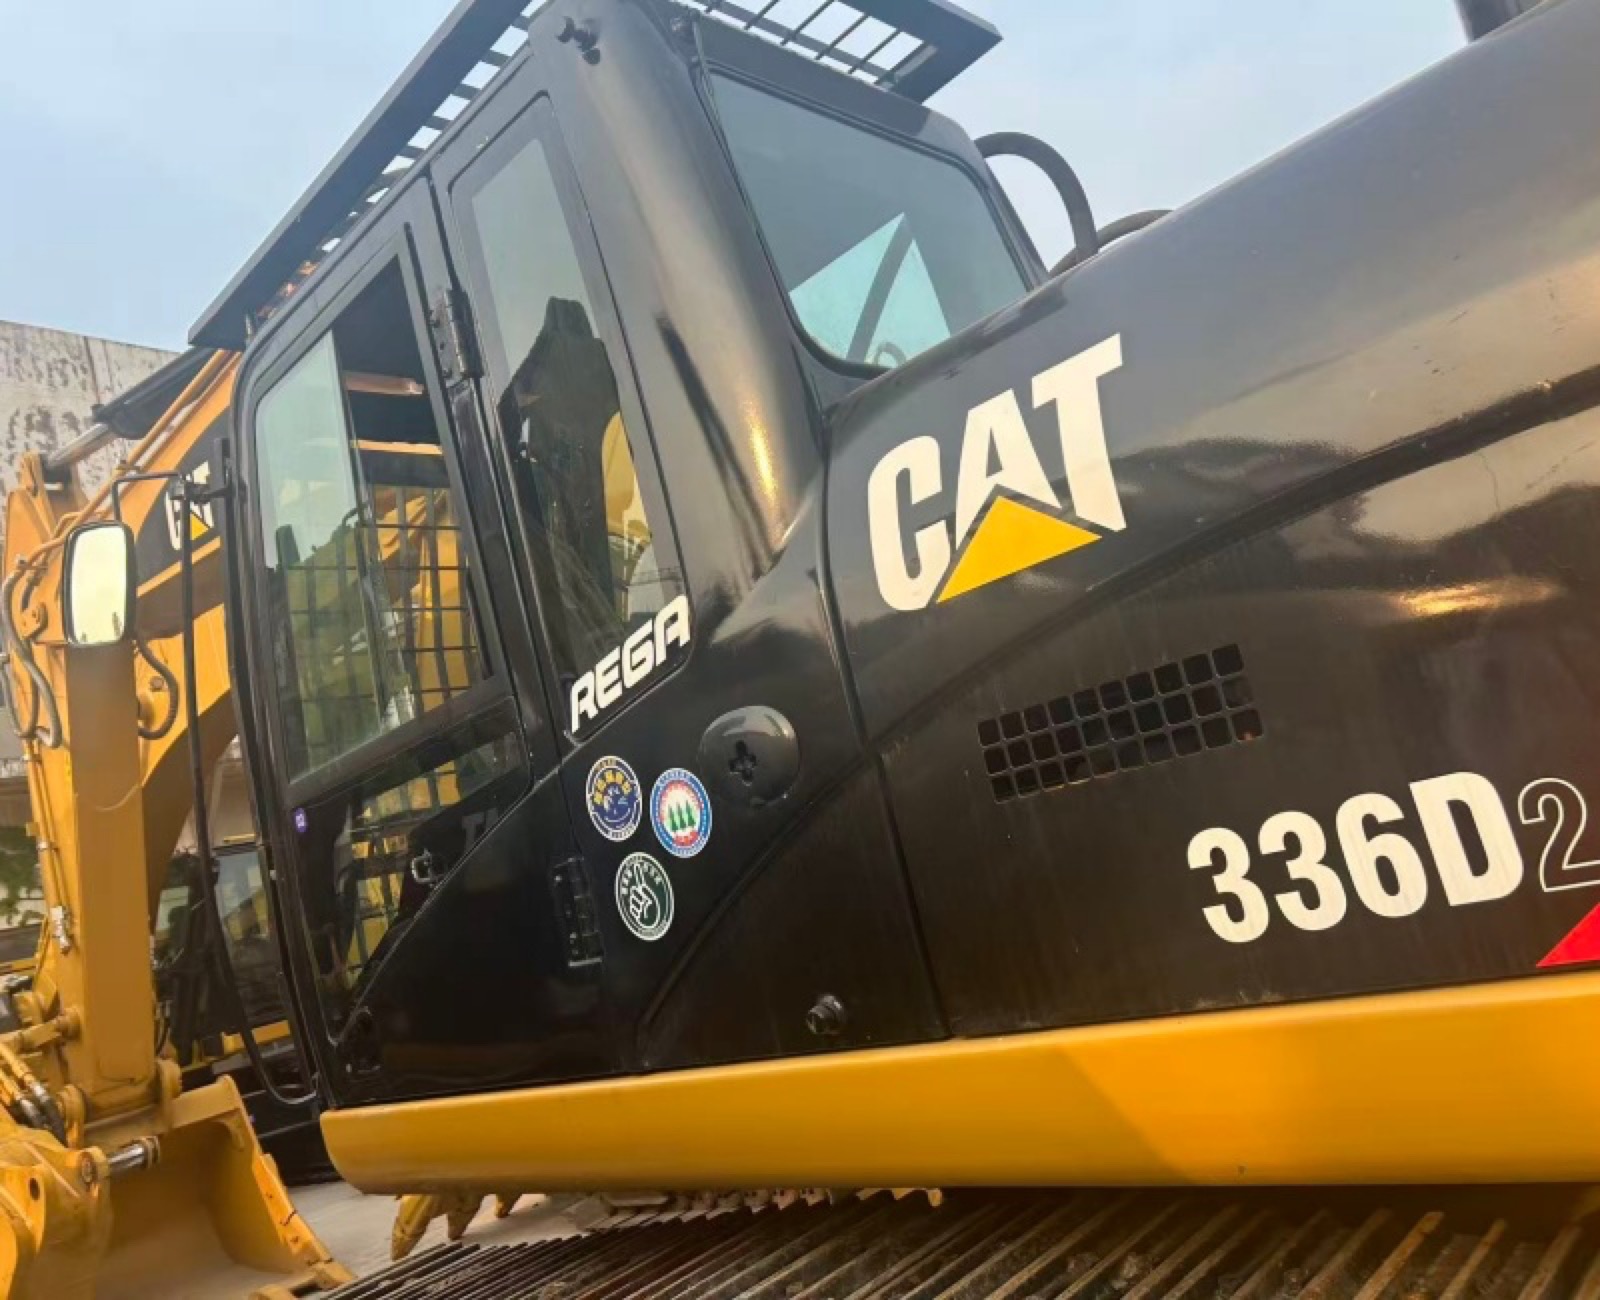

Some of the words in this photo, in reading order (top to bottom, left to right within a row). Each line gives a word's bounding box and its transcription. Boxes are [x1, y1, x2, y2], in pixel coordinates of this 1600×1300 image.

[867, 332, 1127, 611] CAT
[570, 594, 691, 734] REGA
[1187, 771, 1600, 943] 336D2
